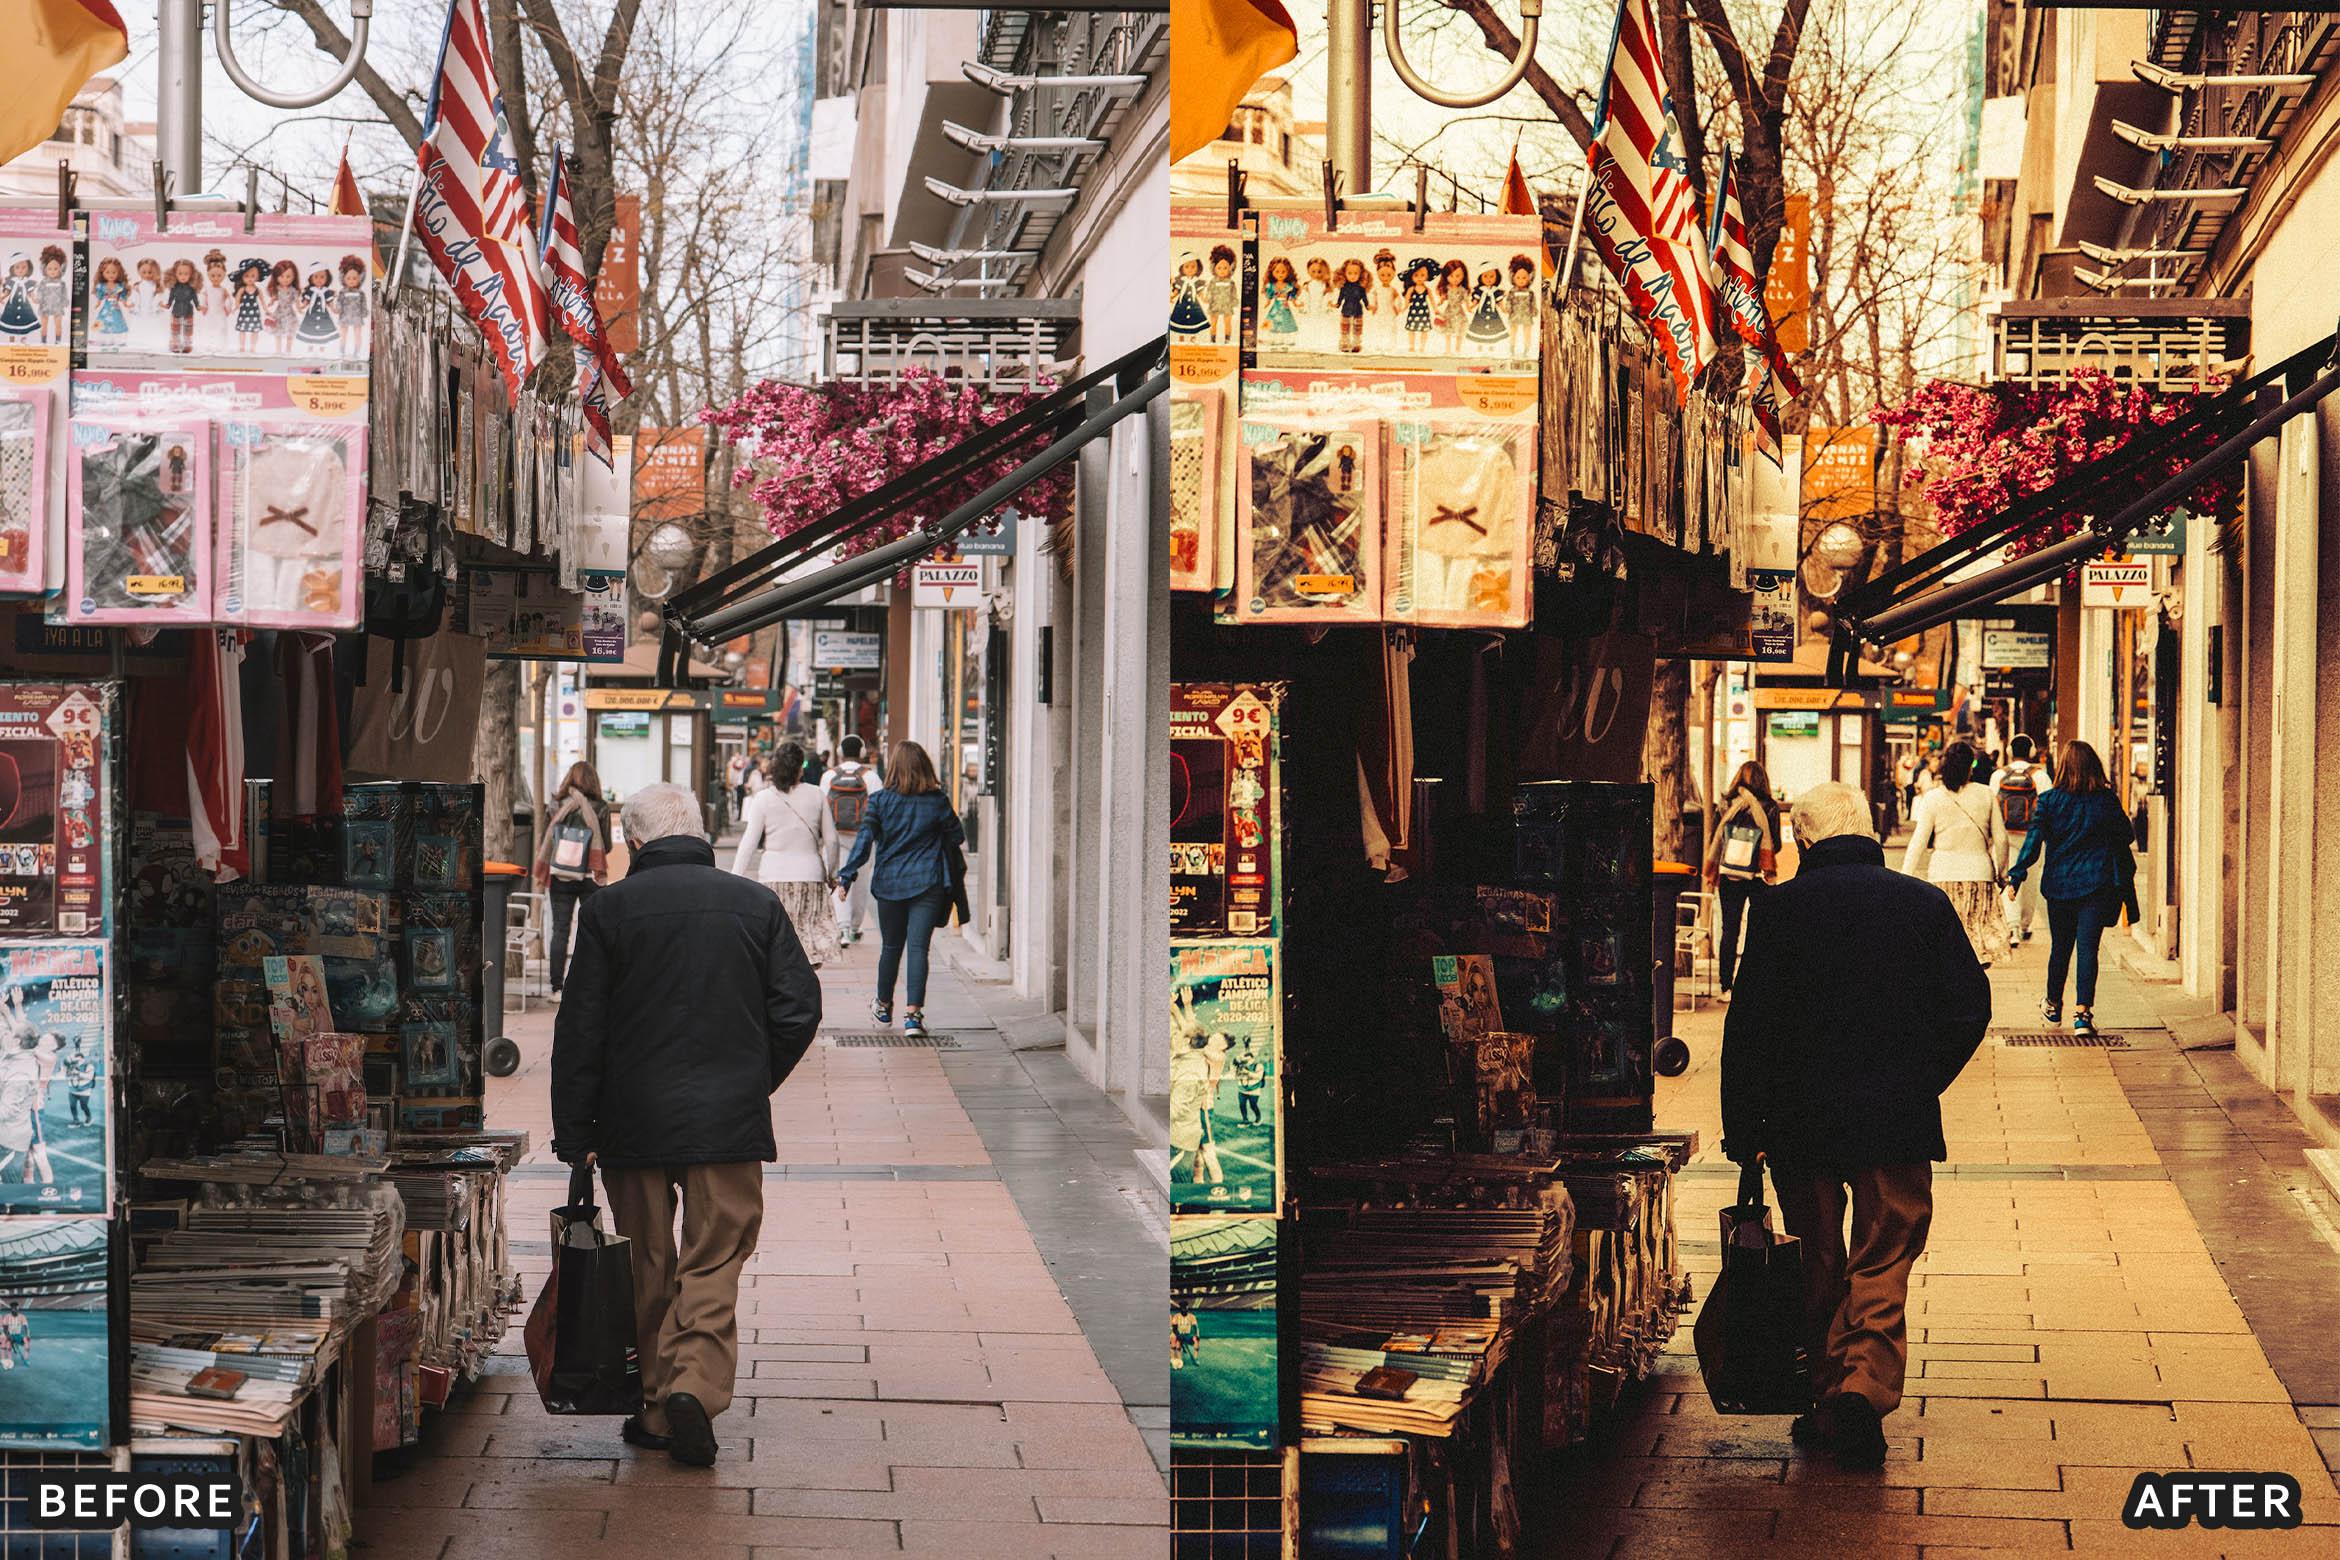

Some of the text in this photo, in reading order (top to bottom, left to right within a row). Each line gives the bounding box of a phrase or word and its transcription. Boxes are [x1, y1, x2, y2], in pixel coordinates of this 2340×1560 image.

[444, 237, 483, 287] de
[1614, 237, 1653, 287] de
[862, 319, 1056, 393] HOTEL
[2032, 319, 2226, 393] HOTEL
[974, 542, 1005, 550] banana
[2144, 542, 2175, 550] banana
[919, 571, 978, 582] PALAZZO
[2089, 571, 2148, 582] PALAZZO
[72, 628, 82, 645] A
[87, 629, 104, 646] LA
[266, 958, 286, 973] TOP
[1436, 958, 1456, 973] TOP
[51, 976, 99, 990] ATLÉTICO
[1221, 976, 1269, 990] ATLÉTICO
[49, 988, 99, 1001] CAMPEÓN
[1219, 988, 1269, 1001] CAMPEÓN
[47, 1012, 99, 1024] 2020-2021
[1217, 1012, 1269, 1024] 2020-2021
